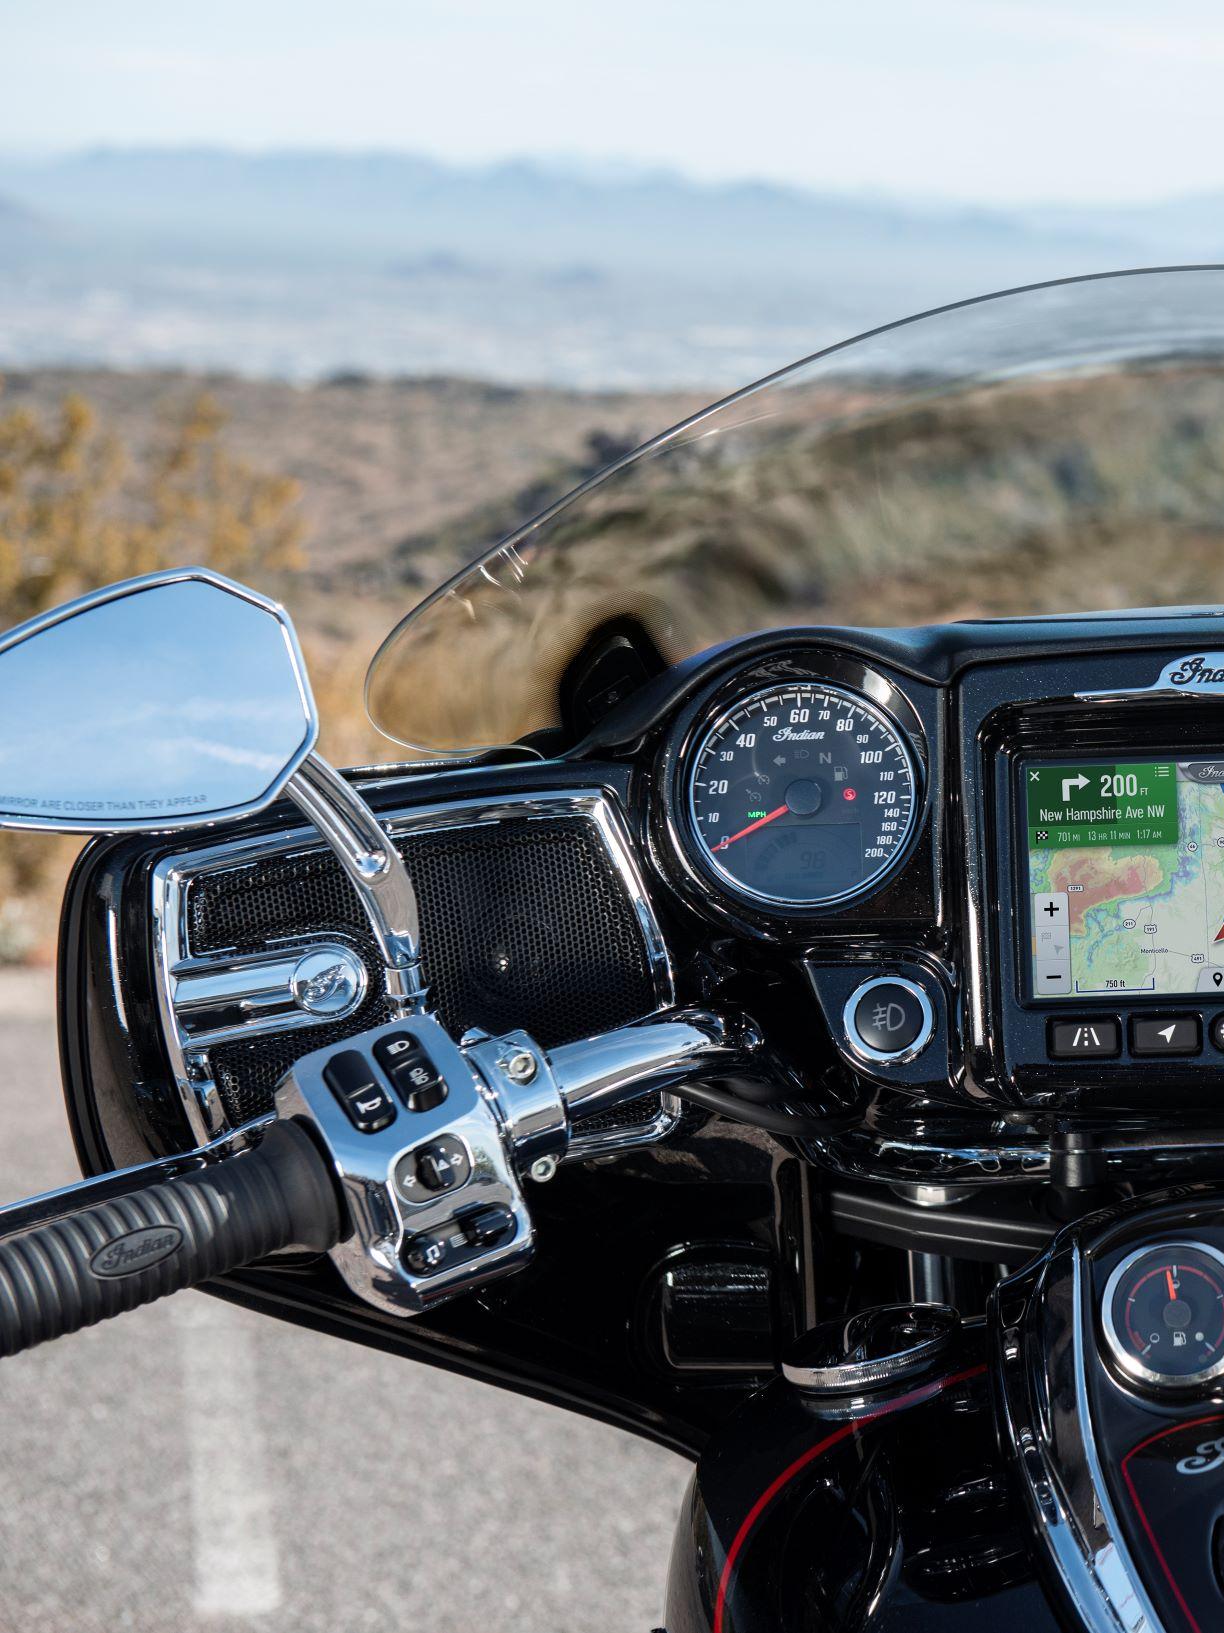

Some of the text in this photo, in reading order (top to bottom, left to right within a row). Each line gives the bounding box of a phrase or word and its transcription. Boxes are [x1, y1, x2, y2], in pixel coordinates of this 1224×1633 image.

[789, 709, 810, 723] 60
[818, 711, 831, 720] 70
[763, 716, 778, 727] 50
[836, 718, 854, 732] 80
[772, 726, 826, 742] Indian
[856, 734, 869, 744] 90
[736, 733, 756, 748] 40
[720, 751, 734, 762] 30
[819, 752, 832, 765] N
[860, 750, 883, 764] 100
[879, 771, 894, 781] 110
[709, 780, 728, 794] 20
[1100, 774, 1149, 797] 200 FT
[873, 791, 896, 804] 120
[708, 812, 719, 823] 10
[884, 808, 900, 818] 140
[1039, 804, 1165, 822] New Hampshire Ave NW
[881, 821, 897, 831] 160
[1057, 832, 1071, 842] 701
[1088, 831, 1097, 841] 13
[1110, 830, 1117, 840] 11
[1119, 832, 1131, 840] MIN
[1137, 829, 1162, 839] 1:17 AM
[876, 835, 892, 845] 180
[865, 847, 884, 858] 200
[1105, 979, 1126, 988] 750 ft
[101, 1234, 175, 1270] Indian
